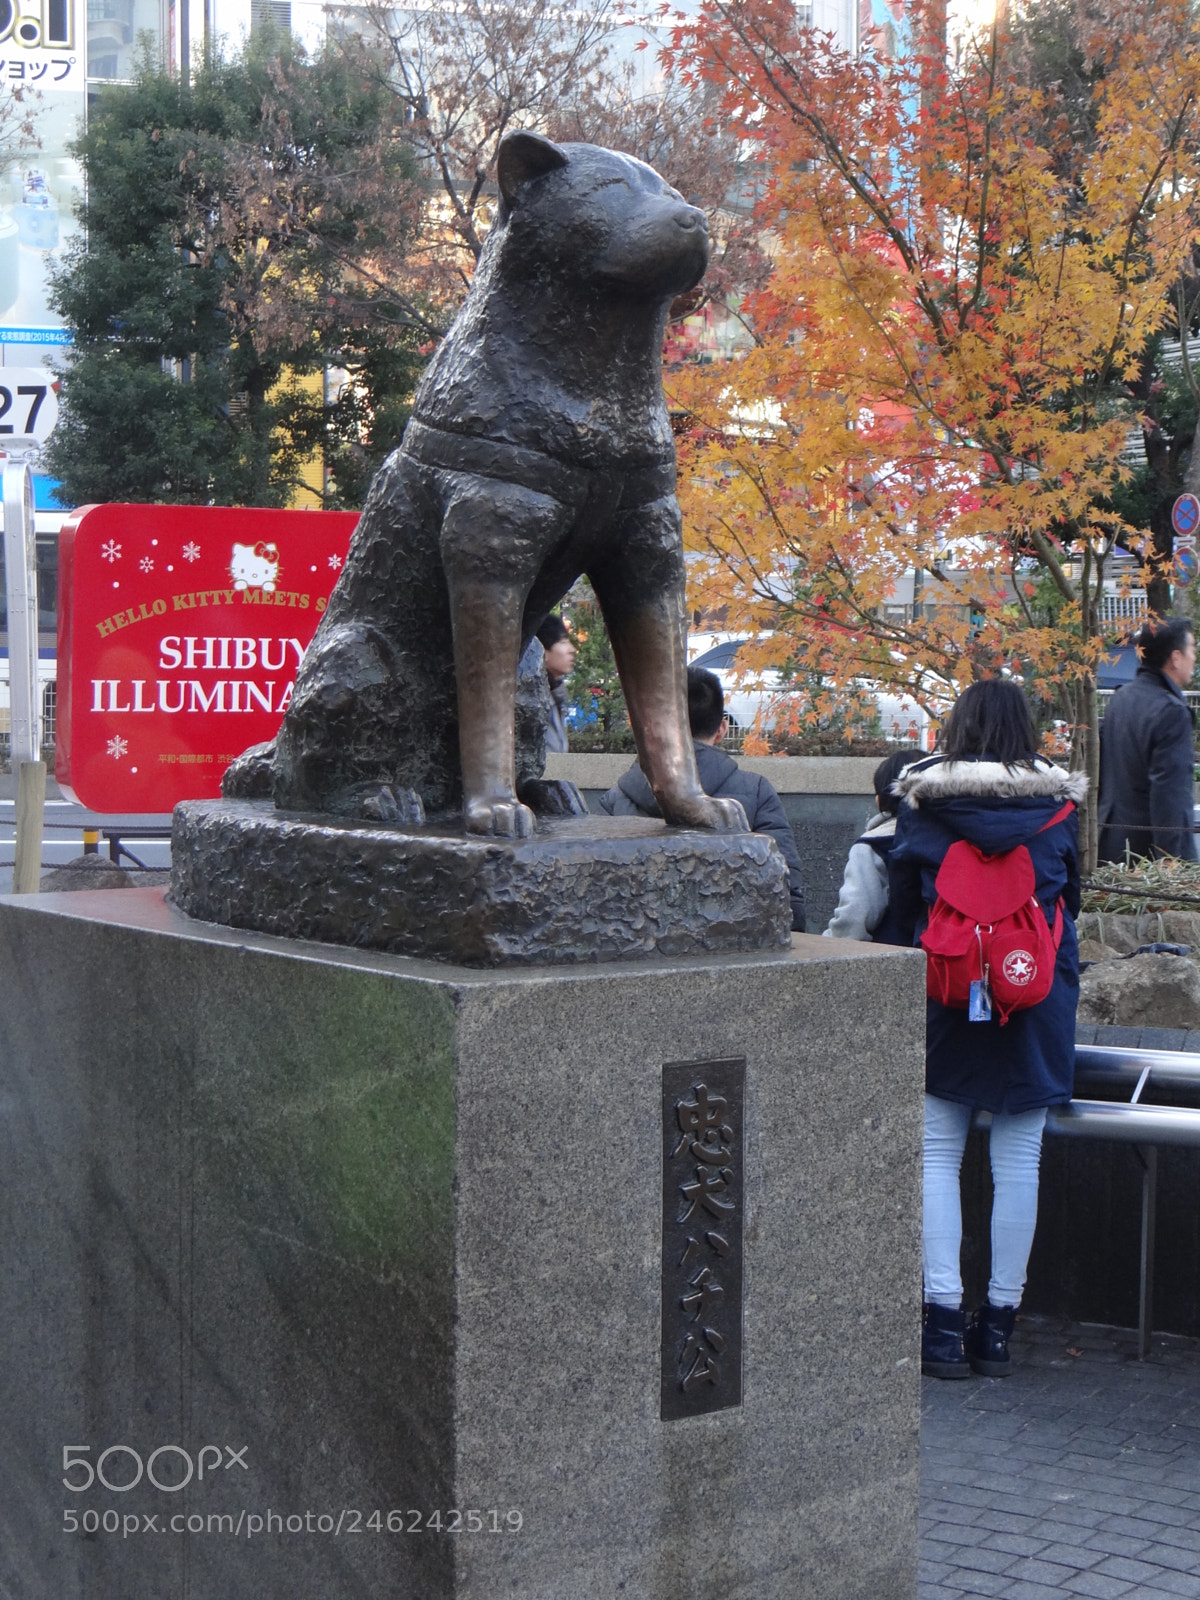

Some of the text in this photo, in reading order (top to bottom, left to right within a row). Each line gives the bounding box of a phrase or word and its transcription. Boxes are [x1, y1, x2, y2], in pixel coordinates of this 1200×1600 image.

[0, 57, 77, 81] ョップ
[96, 599, 167, 638] HELLO
[171, 589, 237, 611] KITTY
[242, 588, 310, 609] MEETS
[671, 1083, 736, 1393] 忠犬ハチ公
